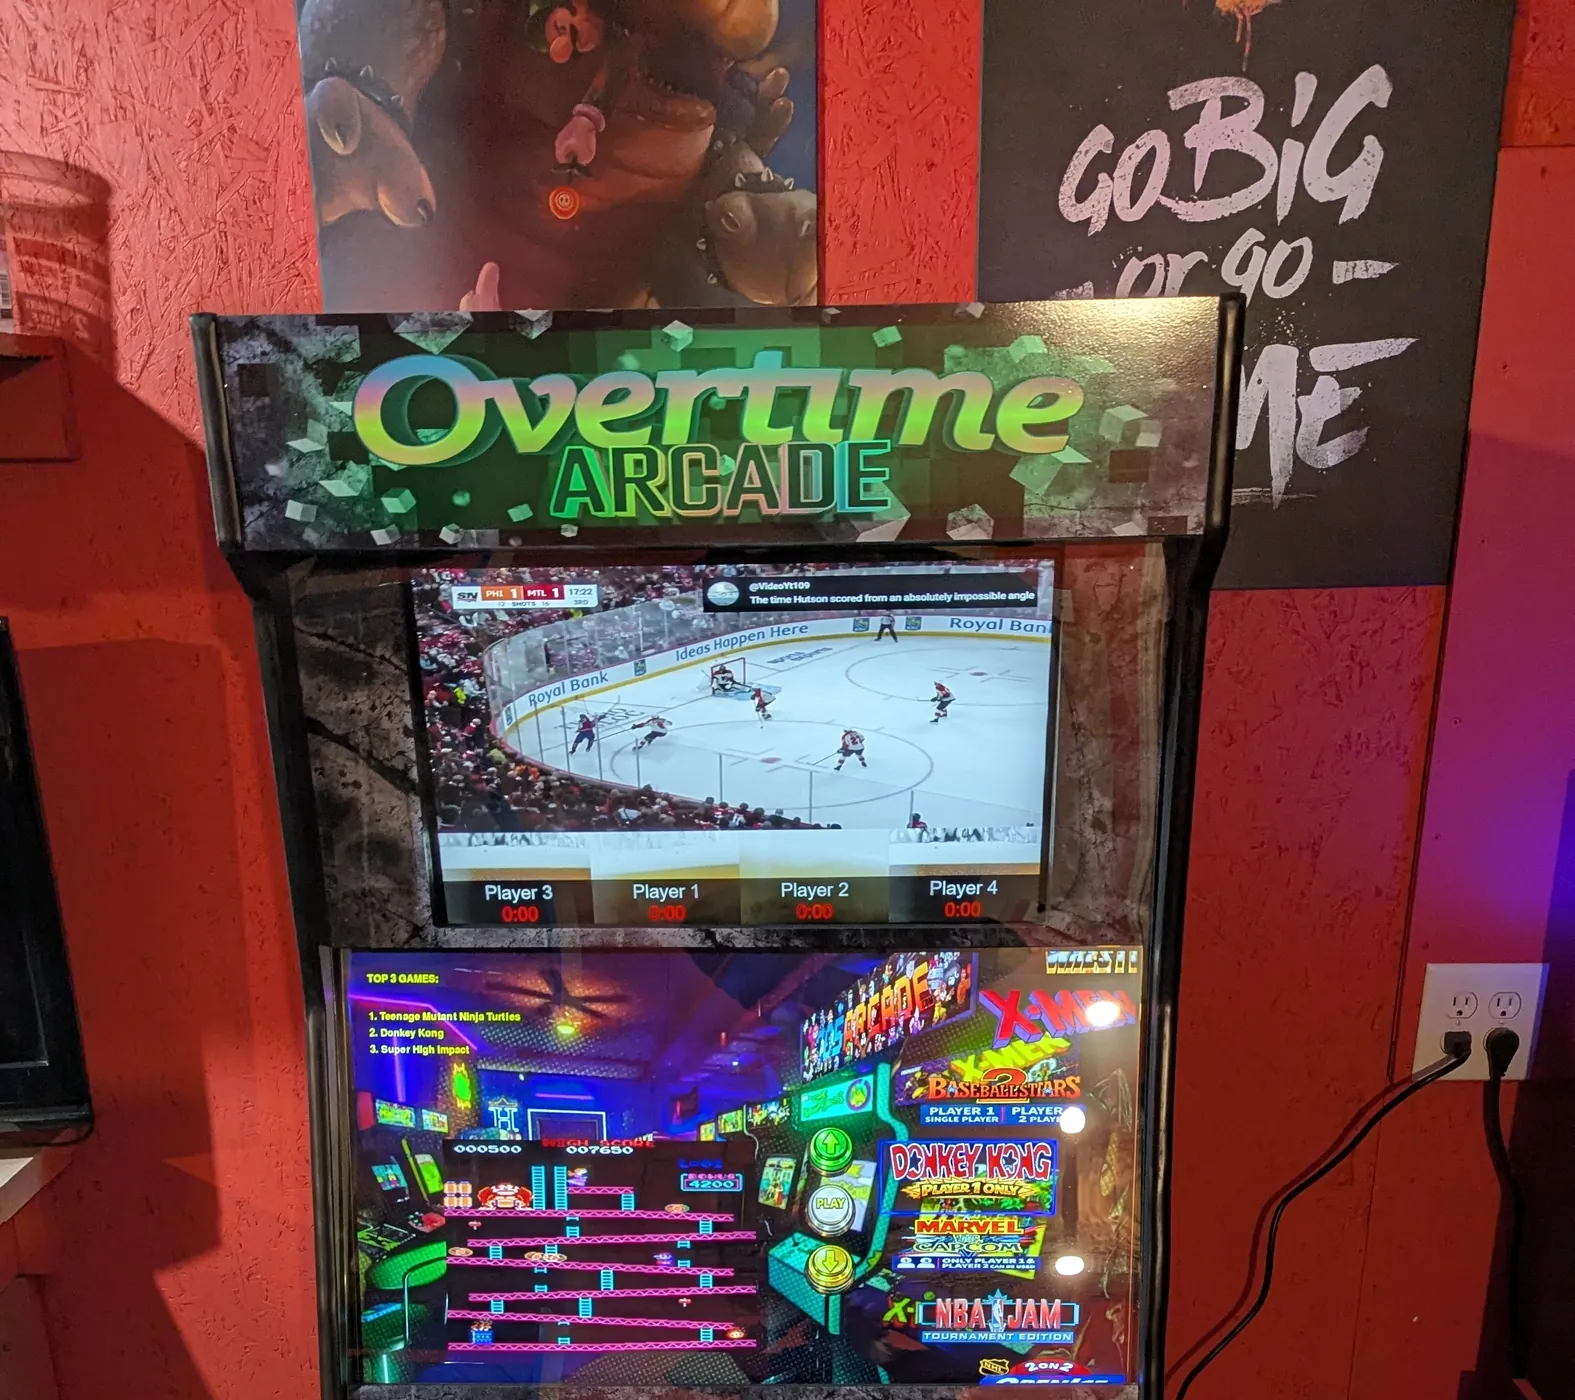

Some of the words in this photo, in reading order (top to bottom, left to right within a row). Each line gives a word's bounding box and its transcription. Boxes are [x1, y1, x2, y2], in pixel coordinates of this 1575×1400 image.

[1058, 123, 1171, 237] GO
[353, 350, 1085, 467] Overtime
[1235, 337, 1421, 509] ME
[549, 439, 893, 520] ARCADE
[486, 590, 503, 598] PHI
[510, 588, 518, 599] 1
[527, 589, 548, 598] MTL
[552, 588, 560, 598] 1
[569, 588, 593, 596] 17:22
[750, 596, 769, 604] The
[770, 595, 792, 604] time
[794, 595, 829, 604] Hutson
[830, 594, 863, 603] scored
[864, 594, 889, 602] from
[889, 594, 902, 602] an
[903, 592, 953, 602] absolutely
[954, 591, 1007, 602] impossible
[1008, 591, 1035, 601] angle
[949, 617, 1003, 632] Royal
[1010, 620, 1053, 634] Ban
[675, 642, 711, 662] Ideas
[713, 630, 766, 651] Happen
[769, 623, 810, 640] Here
[528, 682, 566, 707] Royal
[570, 671, 608, 693] Bank
[484, 884, 538, 903] Player
[541, 884, 554, 900] 3
[632, 883, 685, 902] Player
[690, 883, 699, 900] 1
[780, 882, 834, 900] Player
[838, 882, 849, 897] 2
[929, 880, 982, 899] Player
[986, 880, 999, 895] 4
[501, 905, 539, 923] 0:00
[648, 905, 686, 921] 0:00
[795, 903, 835, 919] 0:00
[943, 901, 982, 918] 0:00
[366, 973, 389, 984] TOP
[389, 974, 397, 983] 3
[398, 973, 440, 984] GAMES:
[842, 961, 936, 1052] ARCADE
[368, 1011, 378, 1021] 1.
[379, 1011, 421, 1023] Teenage
[422, 1011, 457, 1021] Mutant
[459, 1011, 485, 1023] Ninja
[486, 1011, 521, 1021] Turtles
[368, 1028, 379, 1038] 2.
[380, 1028, 415, 1039] Donkey
[417, 1028, 445, 1039] Kong
[369, 1045, 379, 1054] 3.
[380, 1045, 410, 1056] Super
[412, 1045, 436, 1056] High
[437, 1045, 470, 1056] Impact
[927, 1076, 1019, 1099] BASEBALL
[929, 1106, 983, 1115] PLAYER
[987, 1107, 995, 1115] 1
[1011, 1106, 1063, 1115] PLAYER
[453, 1145, 522, 1154] 000500
[565, 1146, 634, 1155] 007650
[889, 1142, 983, 1181] DONKEY
[986, 1141, 1052, 1181] KONG
[688, 1180, 735, 1188] 4200
[921, 1182, 971, 1197] PLAYER
[971, 1181, 981, 1194] 1
[983, 1182, 1020, 1195] ONLY
[815, 1197, 847, 1210] PLAY
[914, 1218, 1025, 1235] MARVEL
[912, 1241, 1023, 1254] CAPCOM
[935, 1298, 986, 1329] NBA
[1008, 1298, 1062, 1329] JAM
[923, 1332, 1014, 1341] TOURNAMENT
[1018, 1332, 1073, 1341] EDITION
